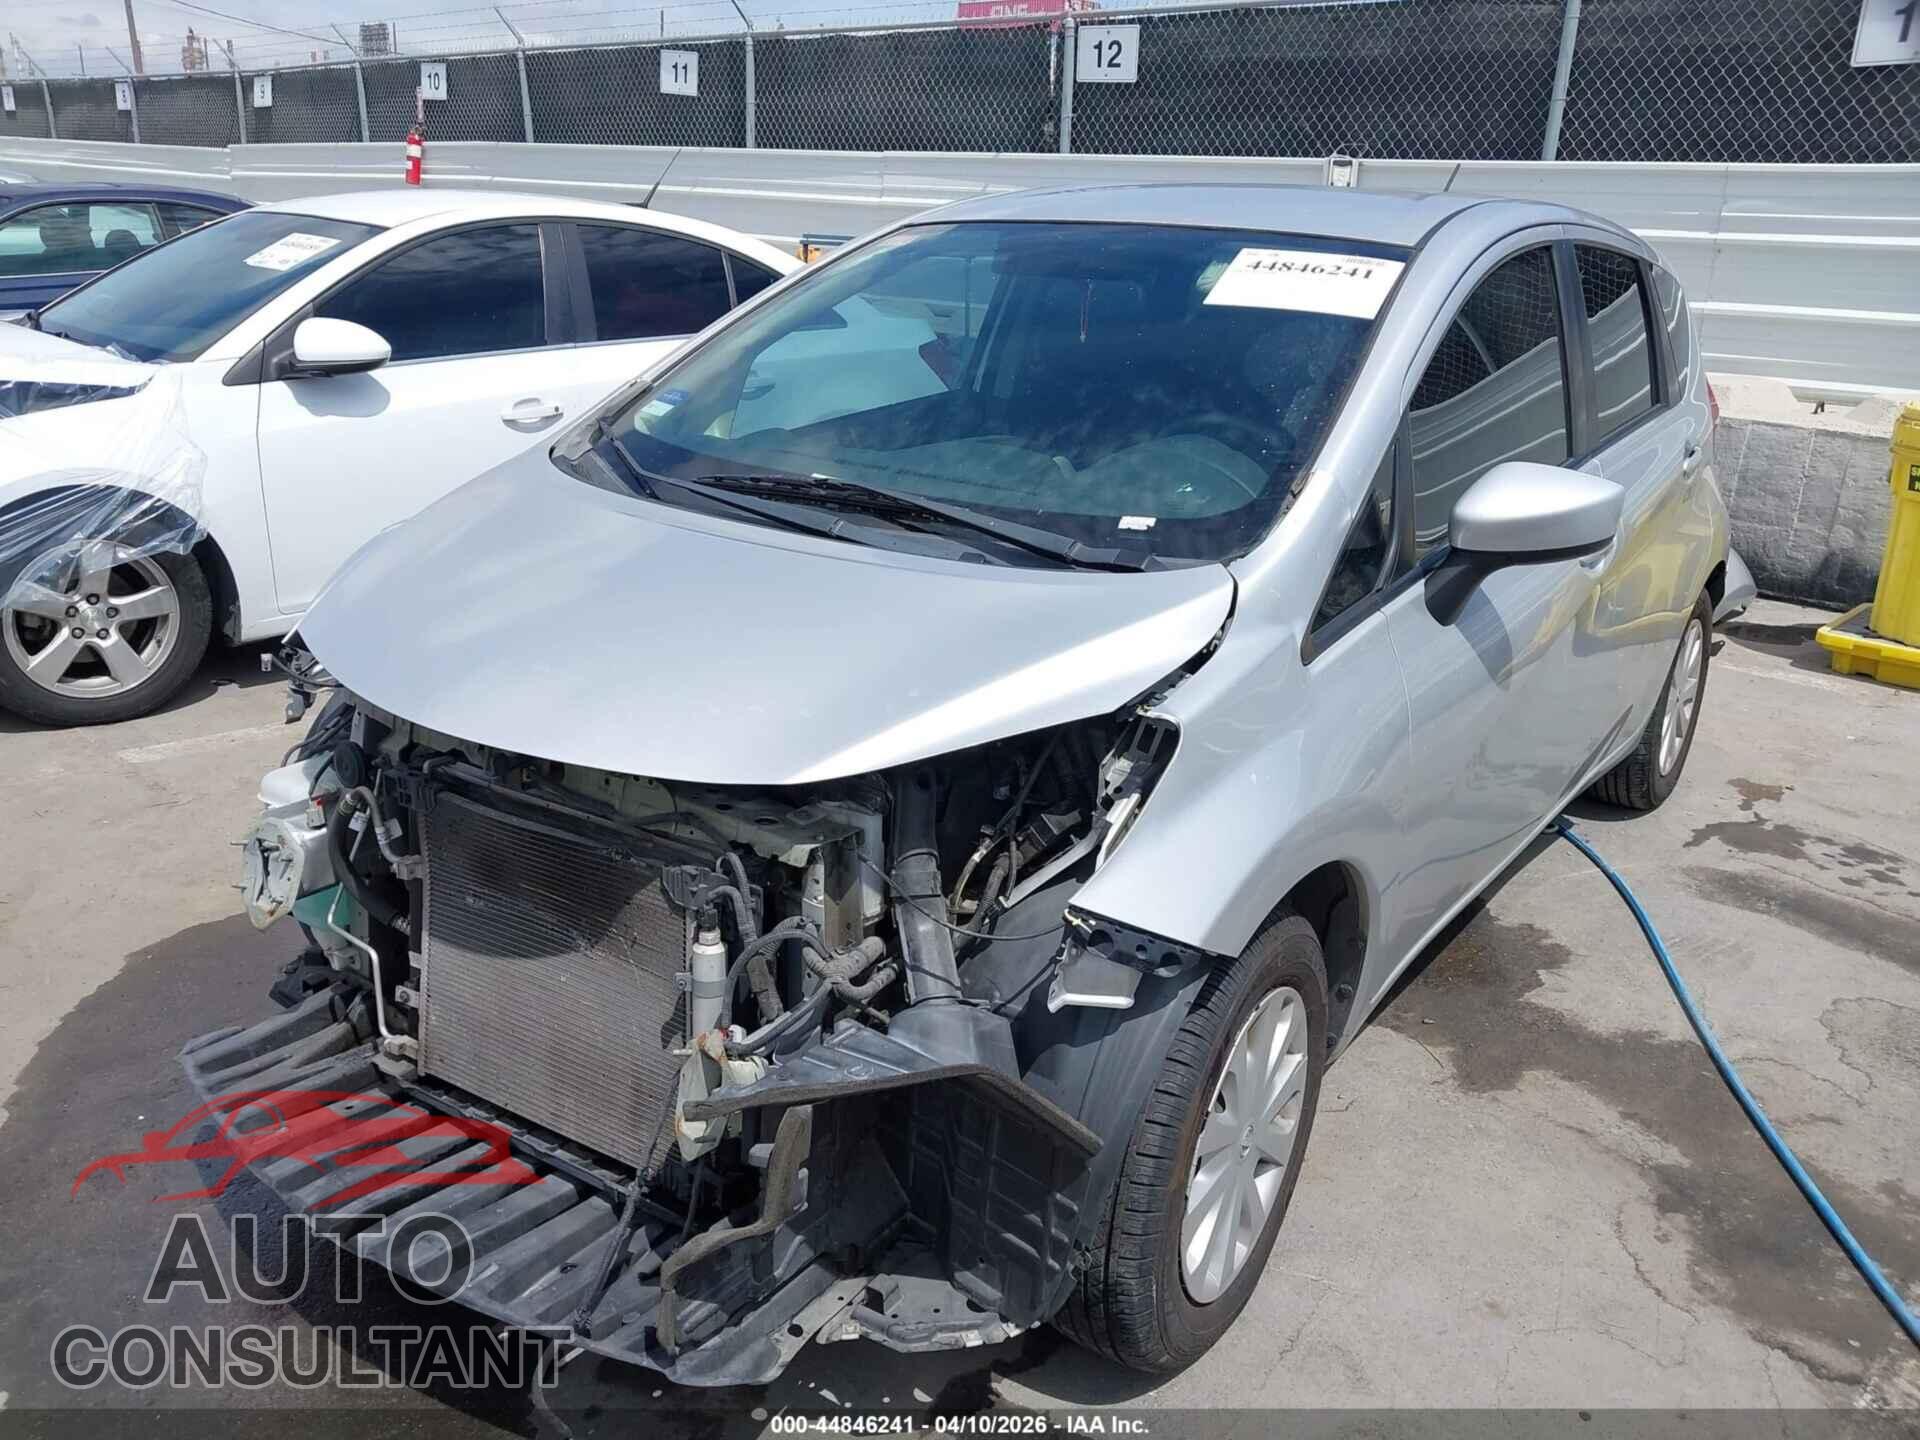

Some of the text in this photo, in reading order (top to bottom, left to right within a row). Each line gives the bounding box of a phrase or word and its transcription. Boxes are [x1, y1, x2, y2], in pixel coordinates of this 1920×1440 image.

[1895, 0, 1918, 43] 1
[1093, 39, 1123, 69] 12
[426, 71, 441, 91] 10
[671, 61, 688, 84] 11
[1247, 259, 1375, 280] 44846241
